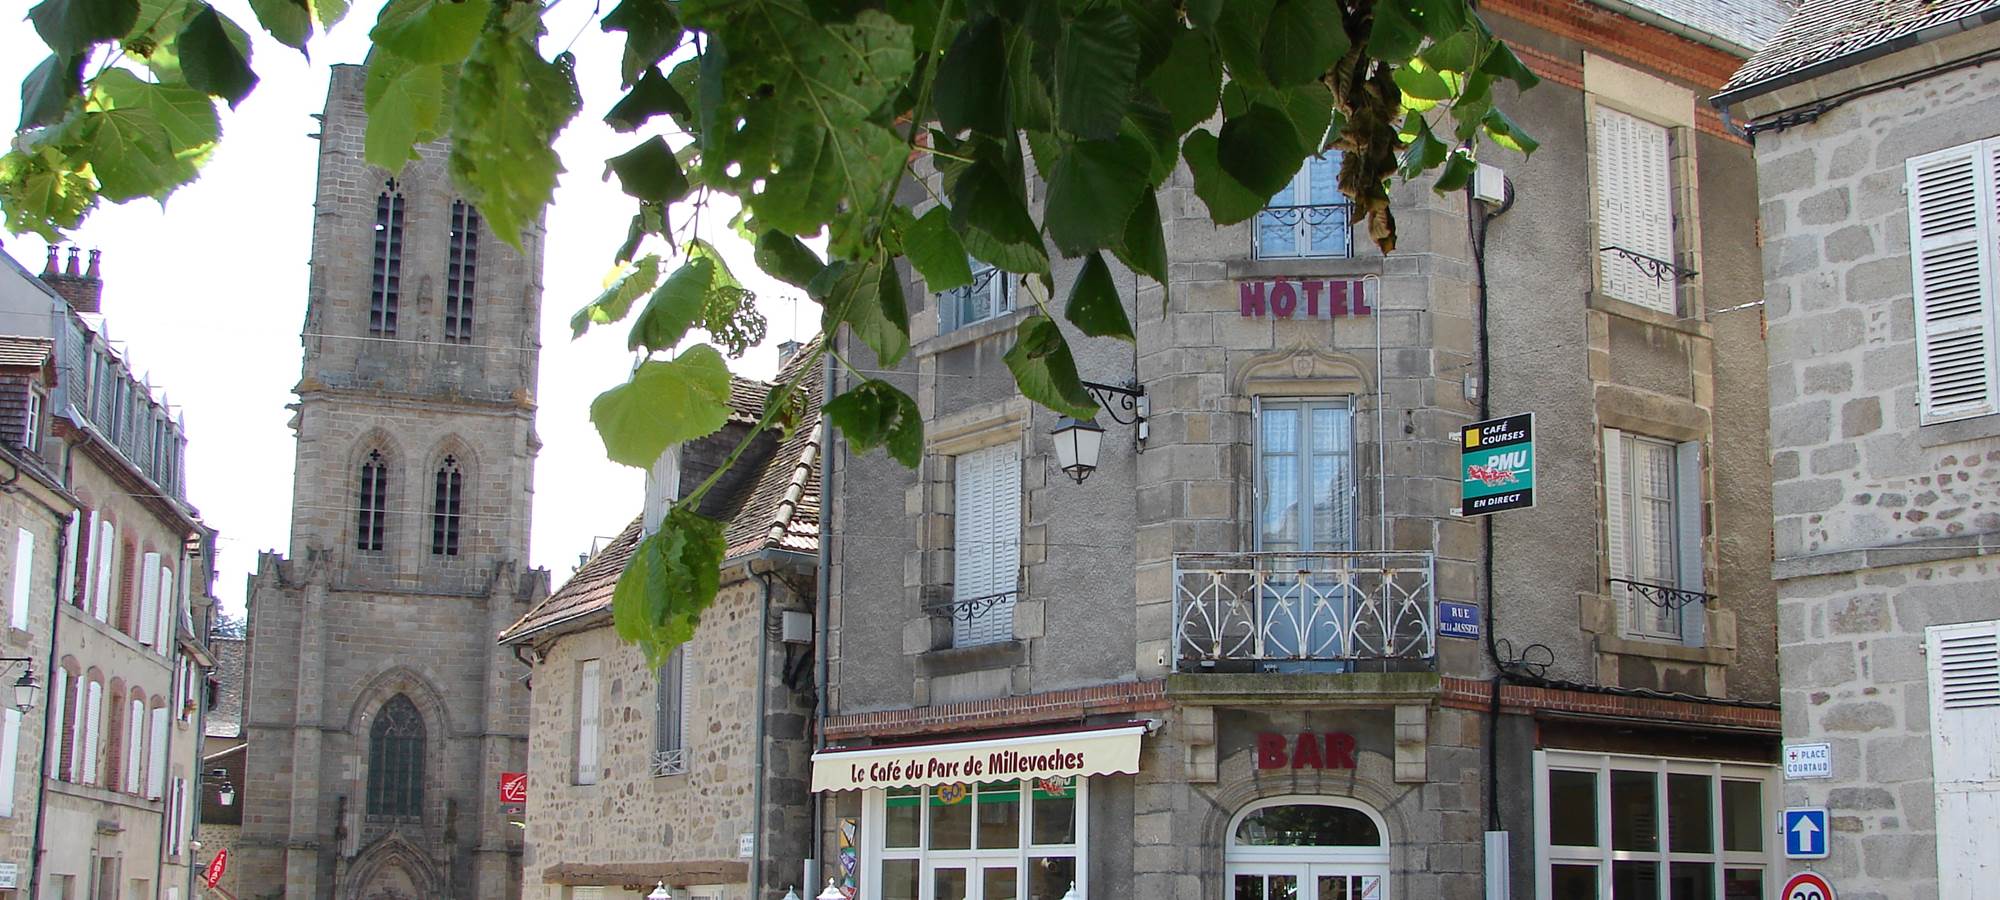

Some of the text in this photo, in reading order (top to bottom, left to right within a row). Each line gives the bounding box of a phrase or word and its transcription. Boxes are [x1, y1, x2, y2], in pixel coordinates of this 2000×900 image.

[1240, 275, 1371, 318] HÔTEL
[1483, 421, 1508, 435] CAFÉ
[1482, 430, 1525, 445] COURSES
[1488, 450, 1527, 471] PMU
[1473, 493, 1520, 508] EN DIRECT
[1451, 607, 1470, 618] RUE
[1257, 732, 1357, 769] BAR
[1801, 750, 1826, 759] PLACE
[851, 748, 1084, 783] Le Café du Parc de Millevaches
[1788, 763, 1828, 772] COURTAUD
[210, 853, 225, 883] TABAC
